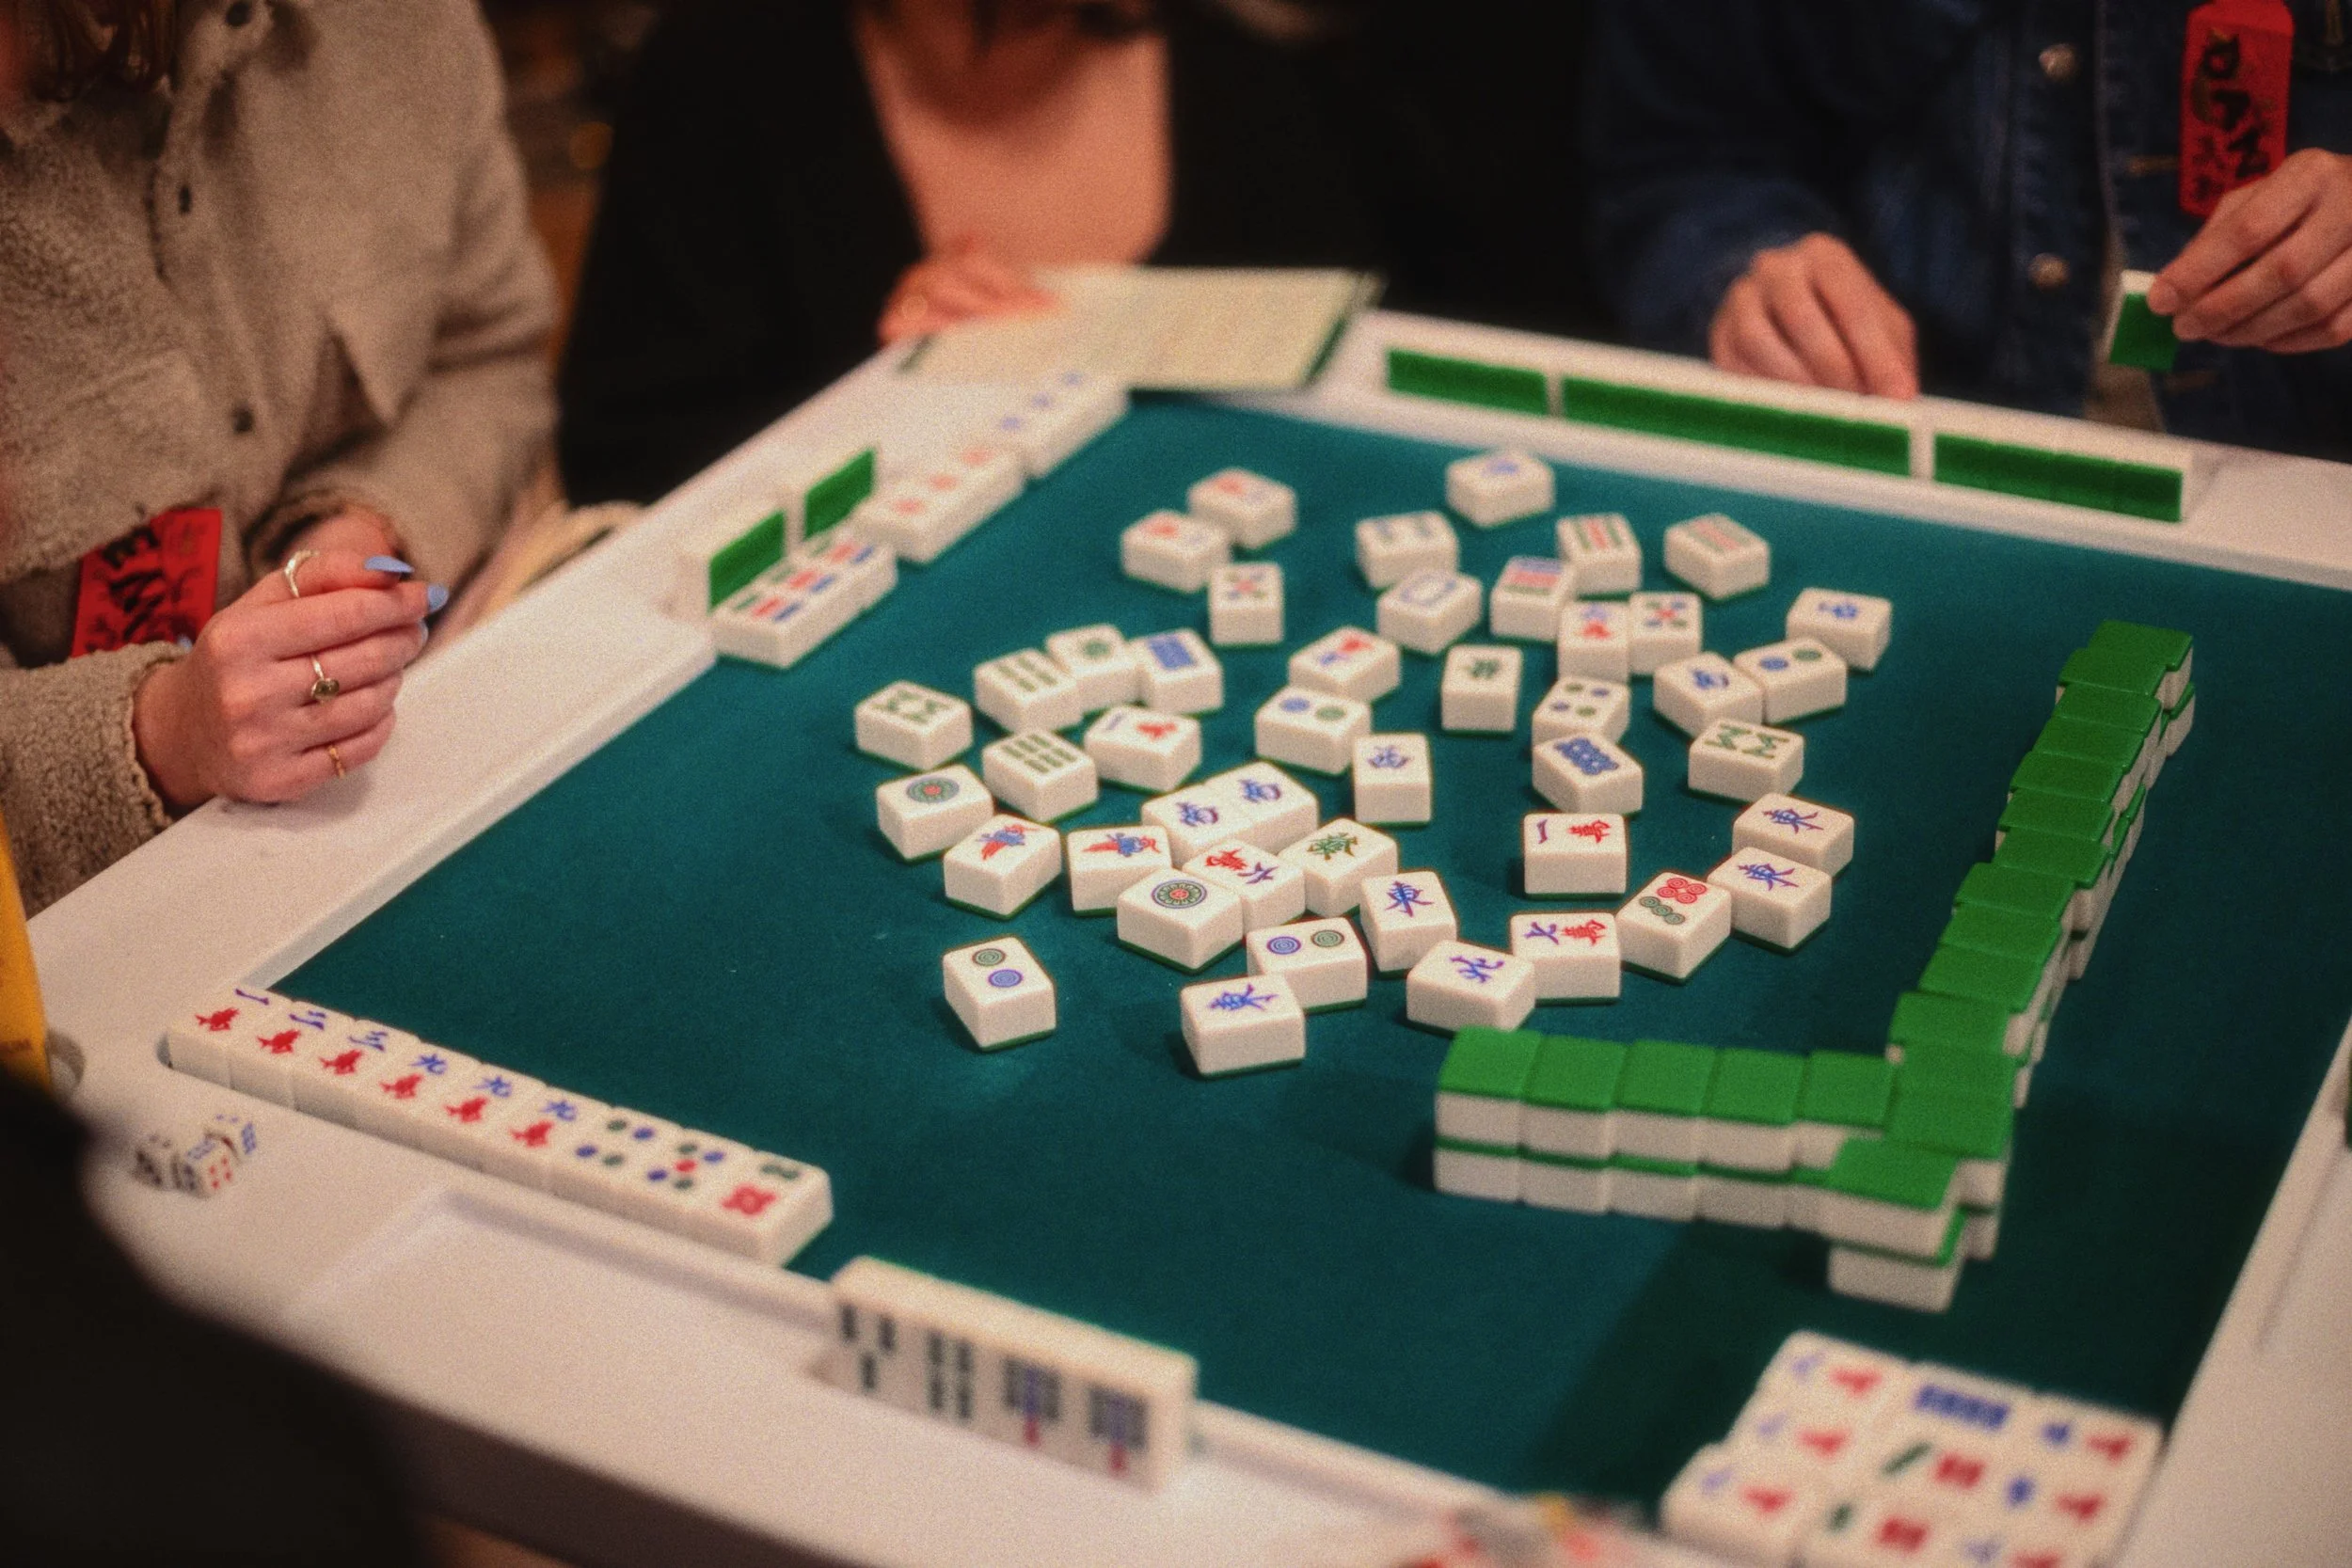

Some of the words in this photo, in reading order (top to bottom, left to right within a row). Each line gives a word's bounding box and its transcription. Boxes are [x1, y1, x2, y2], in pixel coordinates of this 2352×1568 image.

[1761, 807, 1824, 834] 東
[1737, 863, 1800, 892] 東
[1385, 880, 1435, 918] 東
